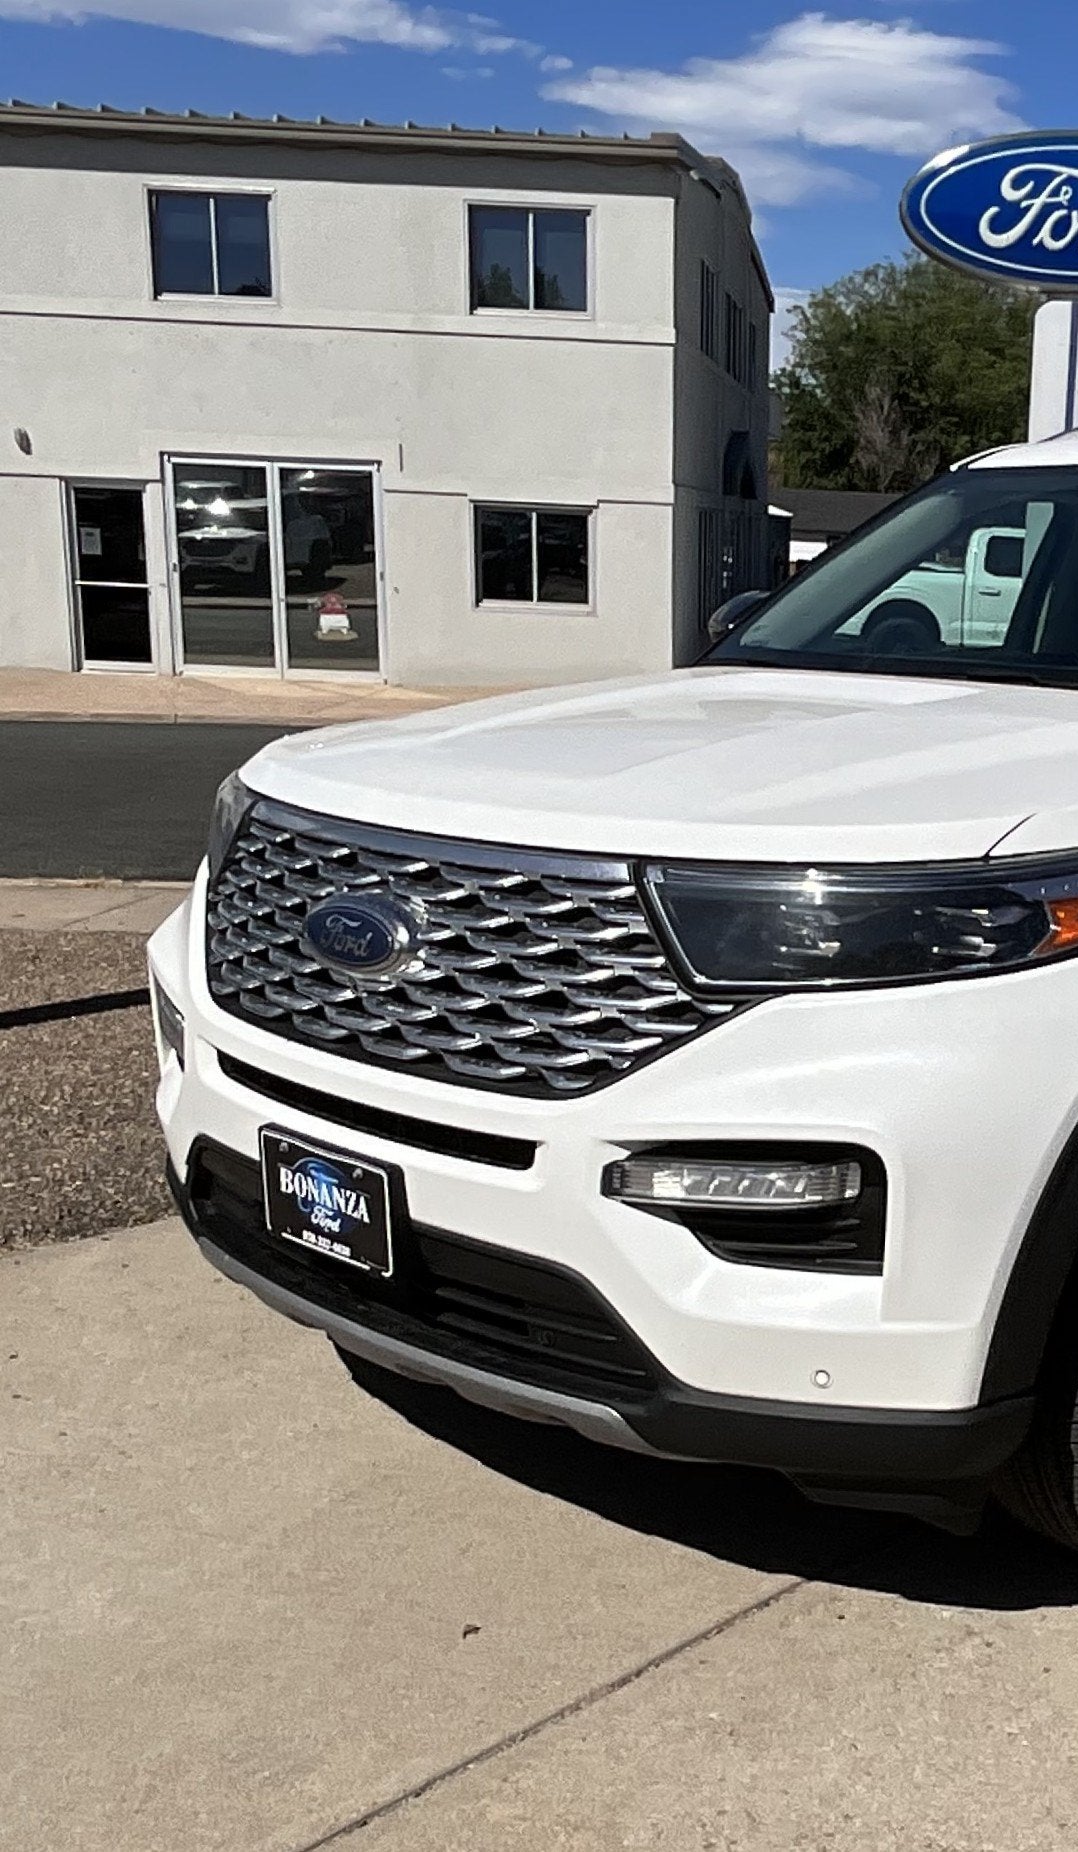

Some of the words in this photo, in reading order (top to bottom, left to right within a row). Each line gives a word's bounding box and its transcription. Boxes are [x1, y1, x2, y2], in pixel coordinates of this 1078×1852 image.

[321, 914, 373, 957] Ford
[279, 1167, 370, 1223] BONANZA
[310, 1206, 341, 1232] Ford
